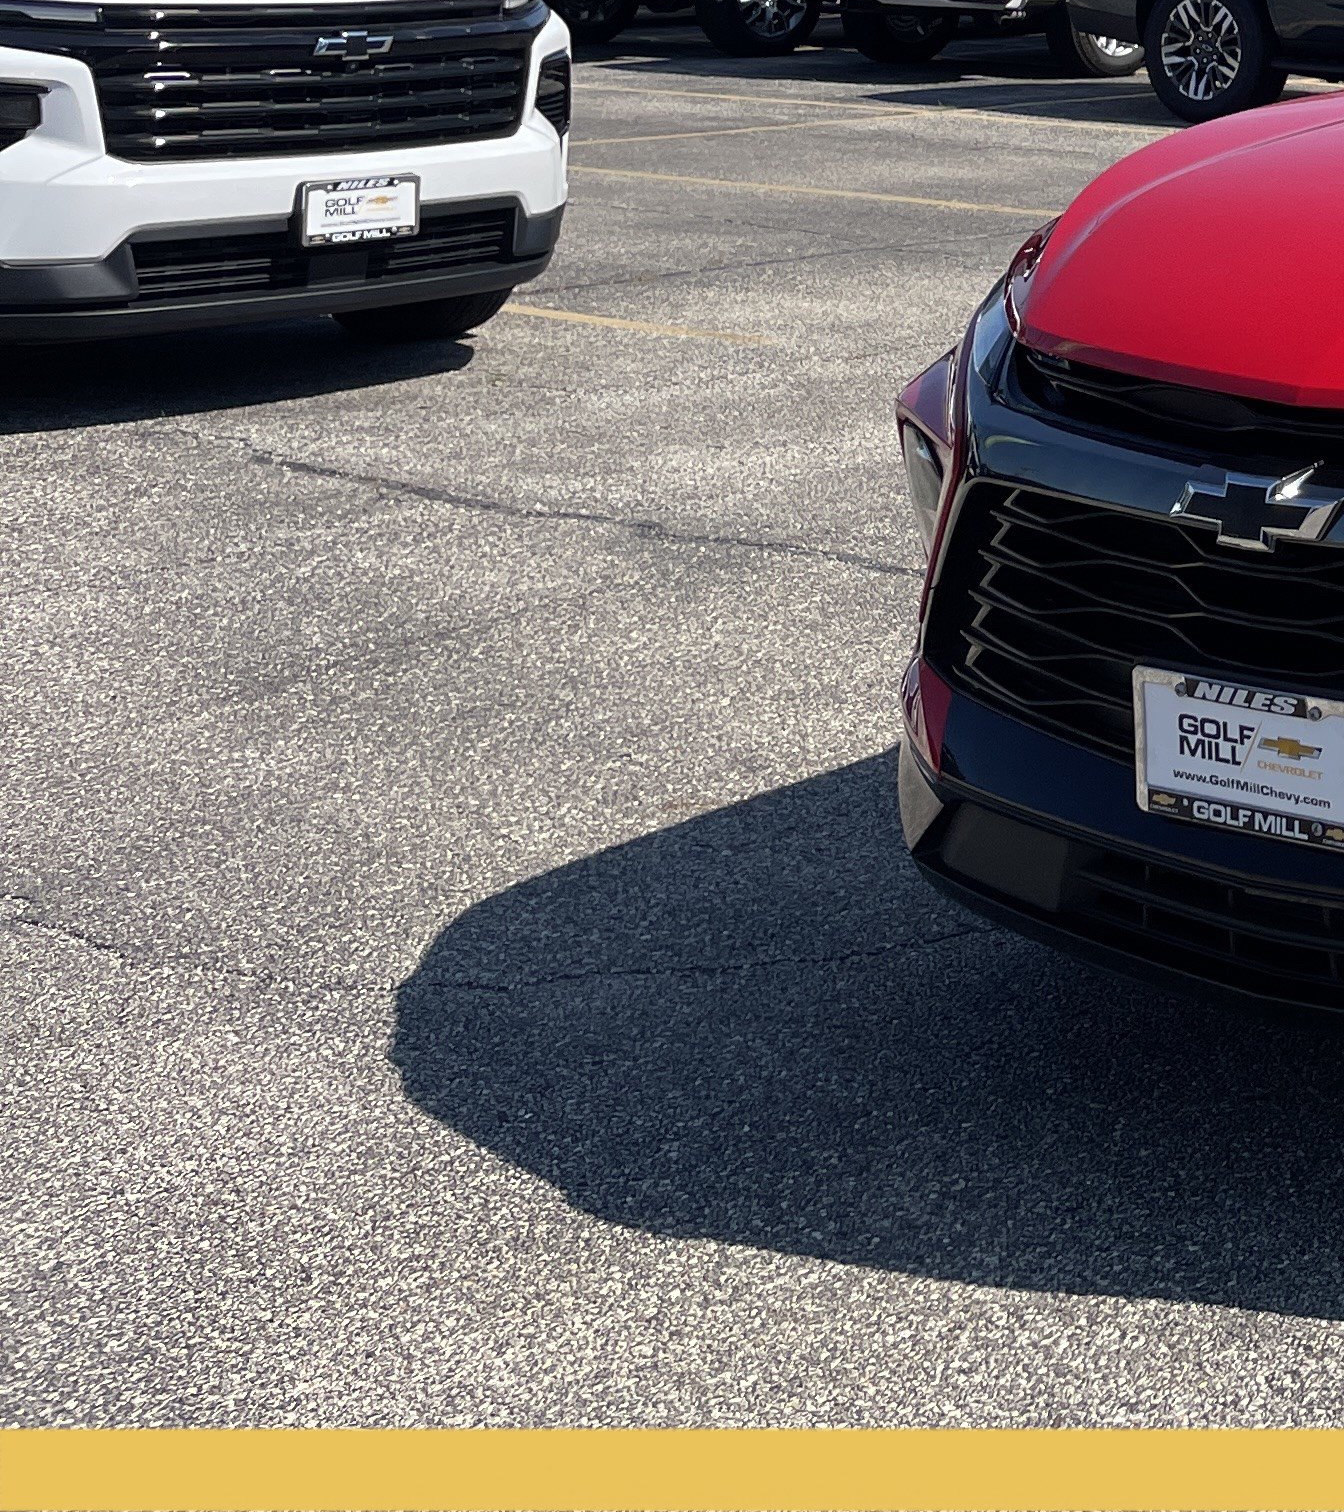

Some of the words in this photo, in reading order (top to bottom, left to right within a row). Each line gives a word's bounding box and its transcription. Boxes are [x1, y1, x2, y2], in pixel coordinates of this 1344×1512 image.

[337, 178, 391, 190] NILES
[324, 207, 357, 217] MILL
[325, 195, 365, 208] GOLF
[331, 231, 363, 243] GOLF
[363, 228, 391, 239] MILL
[1193, 681, 1299, 716] NILES
[1178, 713, 1255, 745] GOLF
[1179, 735, 1243, 767] MILL
[1256, 759, 1324, 781] CHEVROLET
[1172, 768, 1332, 810] www.GolfMillChevy.com
[1192, 801, 1252, 828] GOLF
[1254, 812, 1309, 840] MILL
